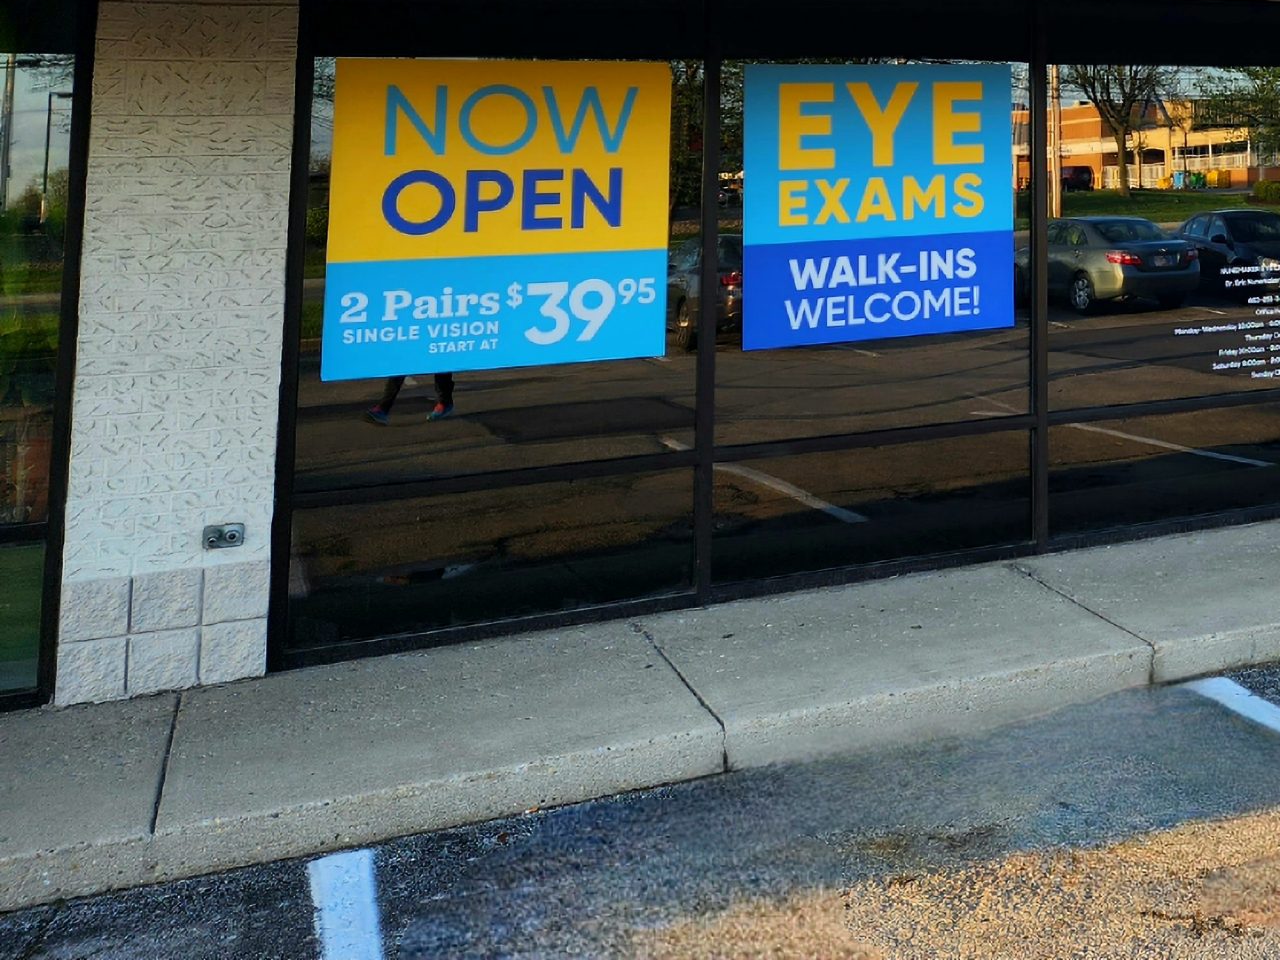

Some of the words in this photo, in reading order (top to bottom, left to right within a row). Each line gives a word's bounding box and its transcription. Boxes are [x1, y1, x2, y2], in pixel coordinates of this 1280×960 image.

[384, 84, 639, 156] NOW
[778, 81, 985, 171] EYE
[381, 167, 623, 236] OPEN
[778, 173, 985, 227] EXAMS
[789, 248, 978, 291] WALK-INS
[339, 291, 369, 324] 2
[381, 286, 500, 322] Pairs
[784, 286, 981, 331] WELCOME!
[342, 325, 420, 344] SINGLE
[427, 321, 499, 339] VISION
[428, 339, 475, 354] START
[480, 338, 499, 351] AT
